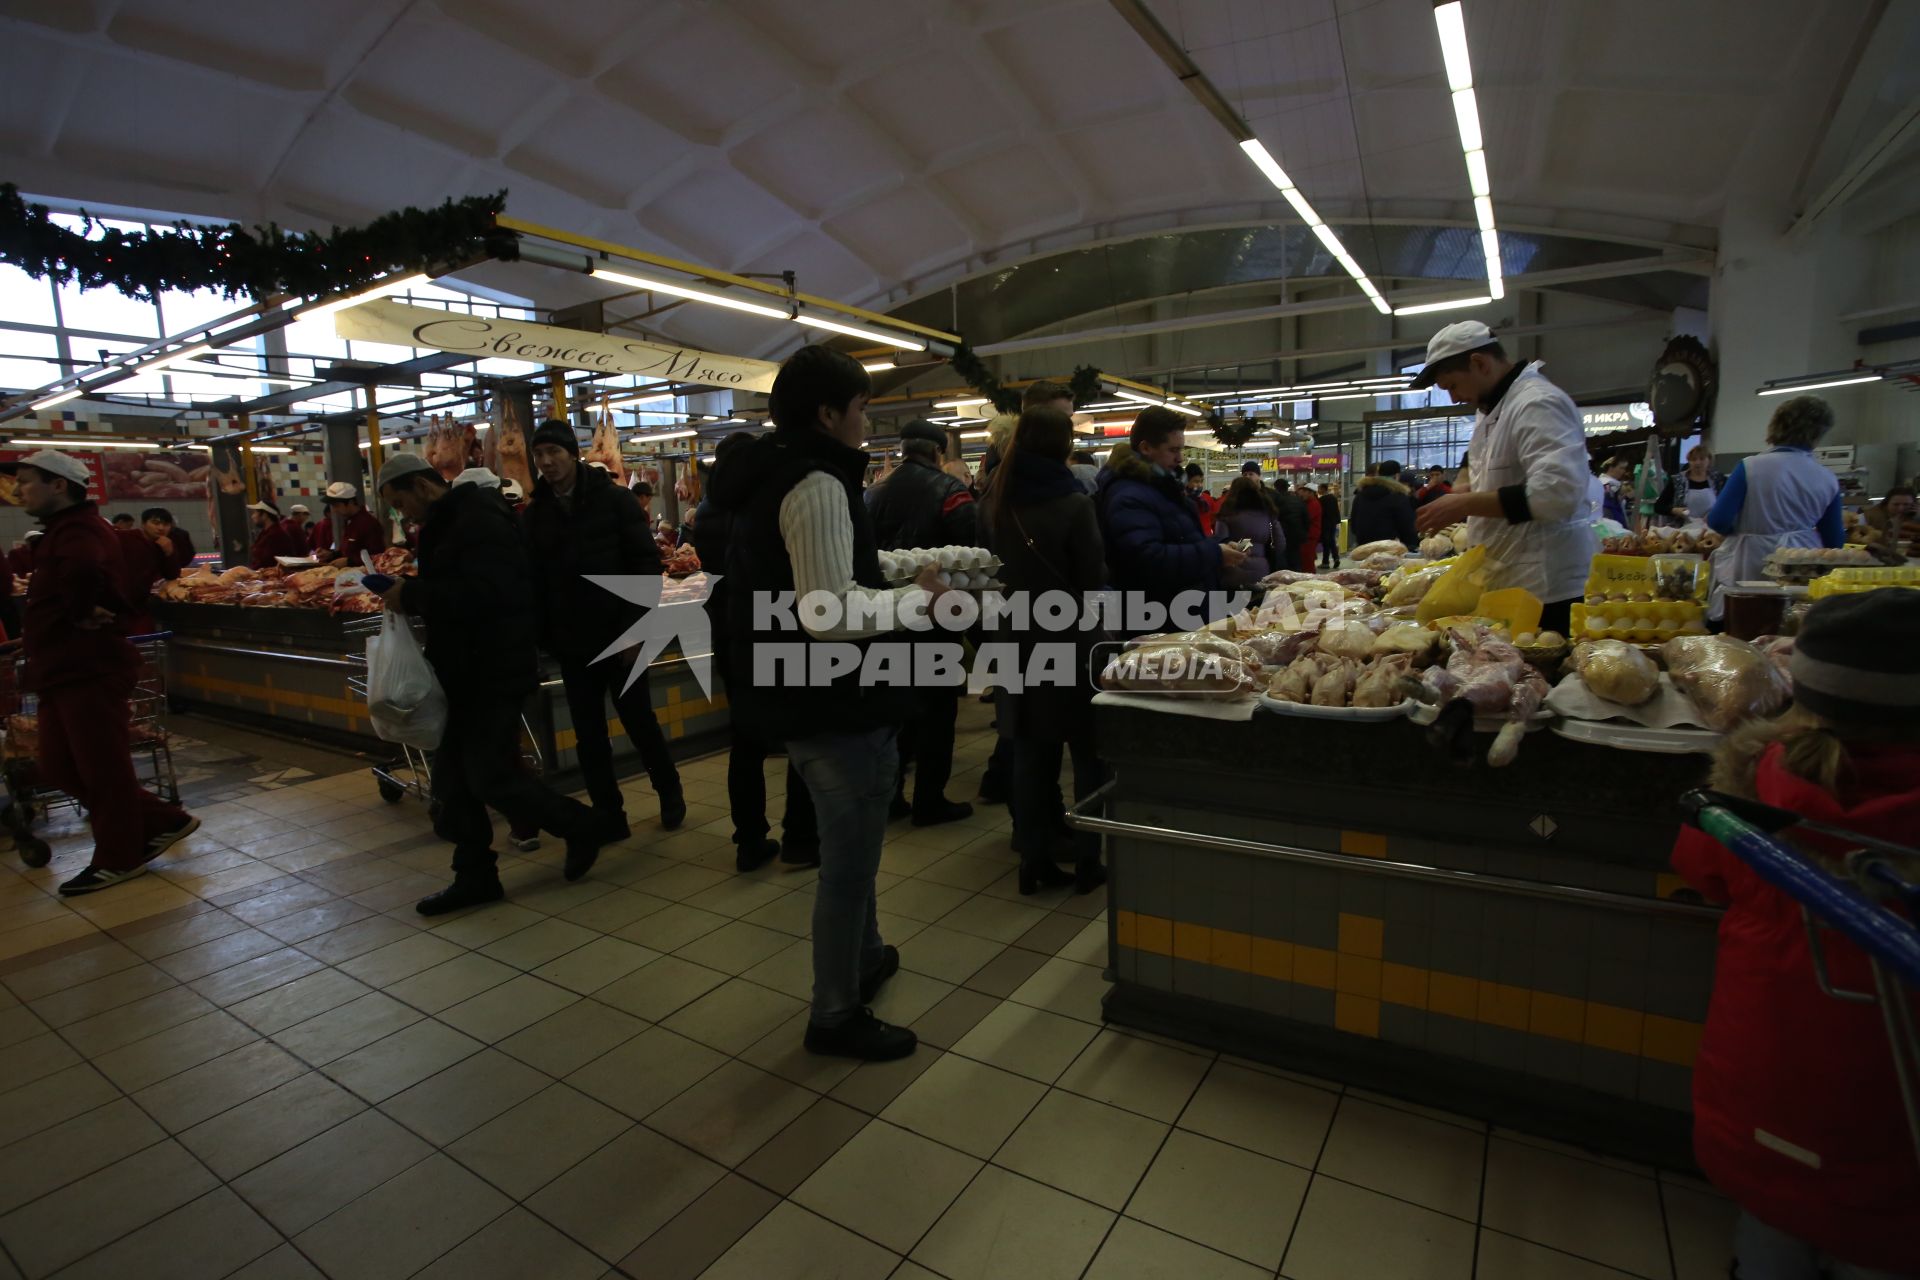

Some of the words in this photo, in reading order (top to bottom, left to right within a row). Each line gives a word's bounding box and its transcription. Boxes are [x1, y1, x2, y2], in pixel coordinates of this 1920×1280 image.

[413, 320, 613, 366] Свежее
[617, 343, 743, 384] Мясо
[1594, 411, 1630, 423] ИКРА
